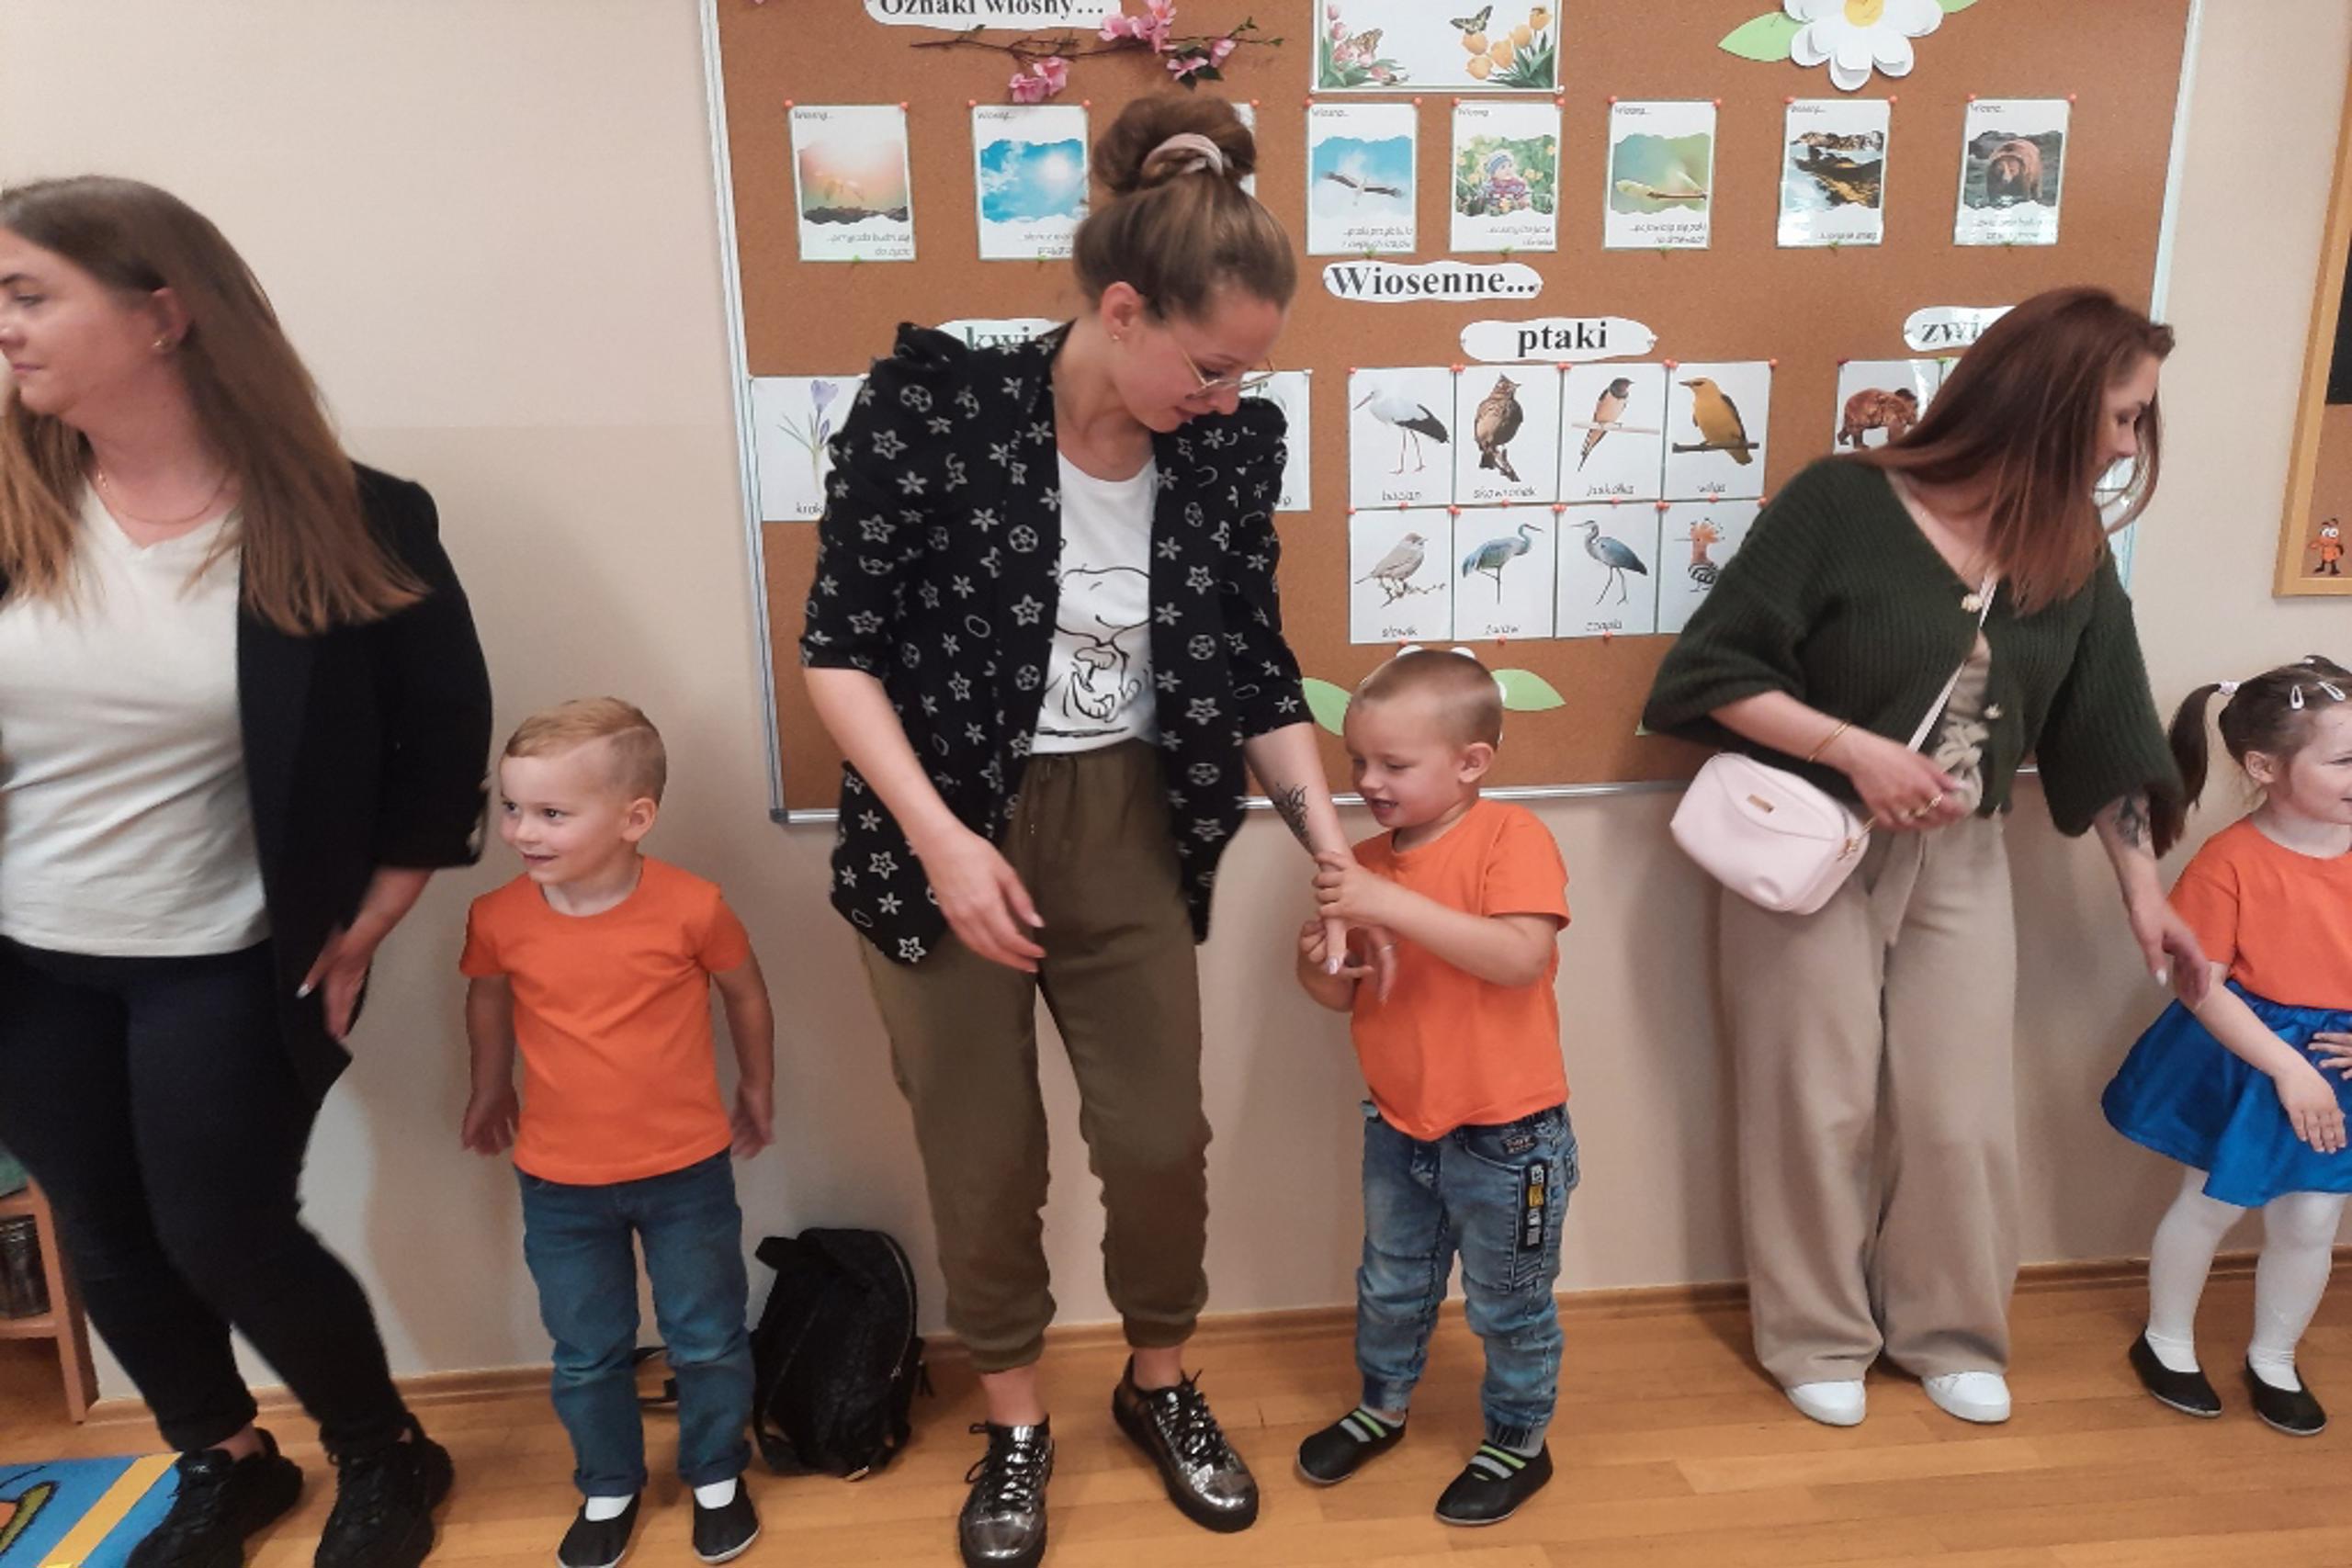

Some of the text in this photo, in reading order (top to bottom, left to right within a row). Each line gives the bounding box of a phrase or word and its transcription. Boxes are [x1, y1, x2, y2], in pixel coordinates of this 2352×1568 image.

[880, 0, 977, 15] Oznaki
[1330, 266, 1536, 296] Wiosenne...
[964, 326, 1030, 349] kwi
[1517, 321, 1608, 357] ptaki
[1921, 314, 1983, 343] zwi
